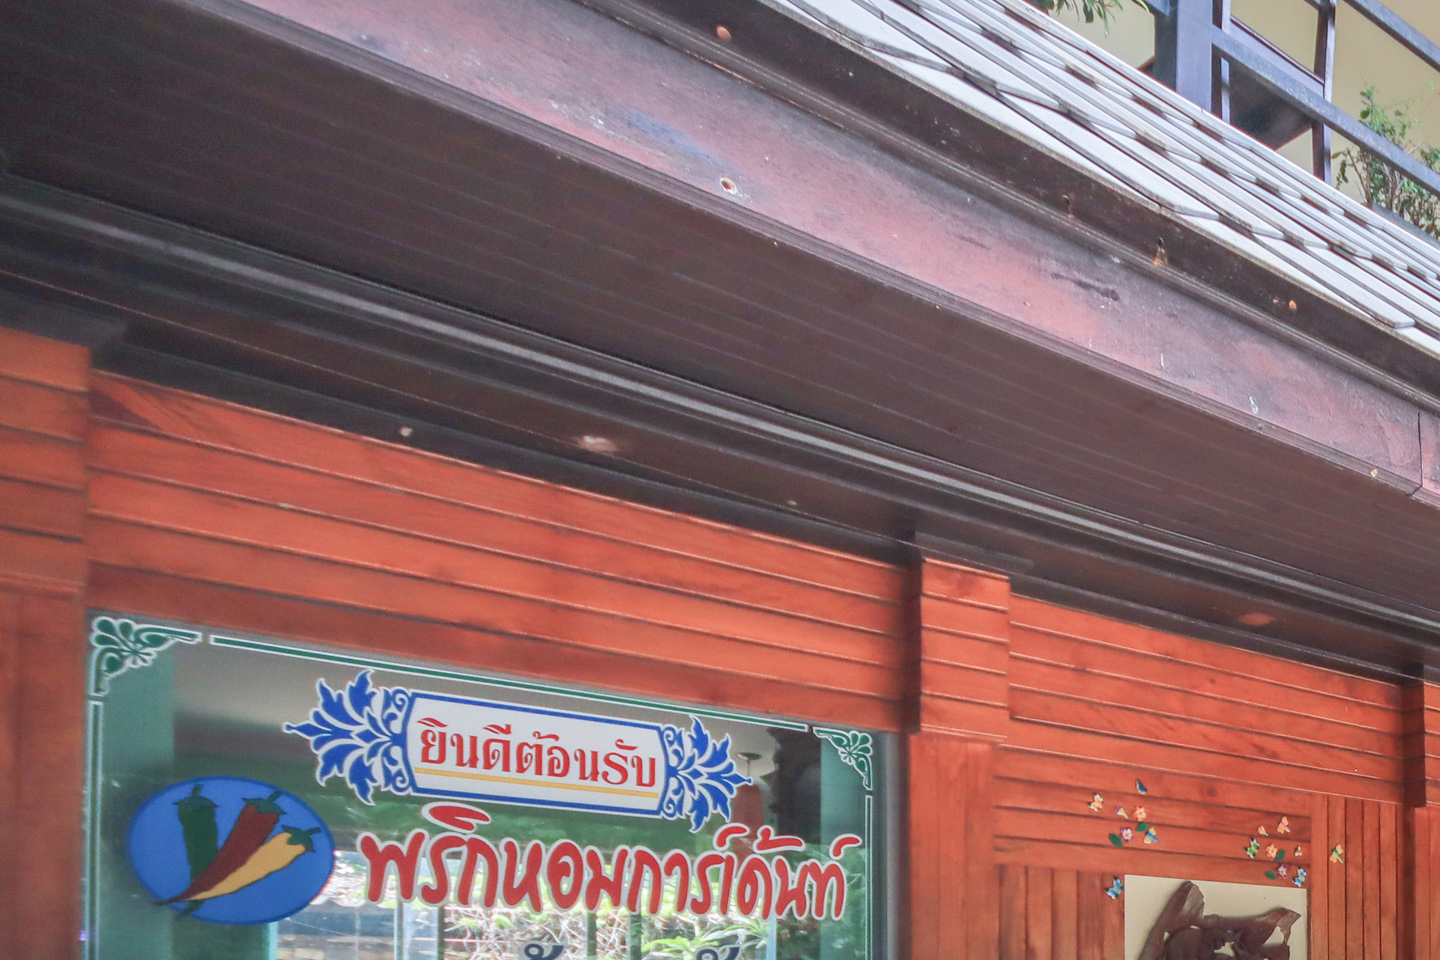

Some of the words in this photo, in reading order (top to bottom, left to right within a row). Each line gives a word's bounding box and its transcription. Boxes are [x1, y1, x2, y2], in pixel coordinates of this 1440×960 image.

[417, 717, 656, 788] ยินดีต้อนรับ
